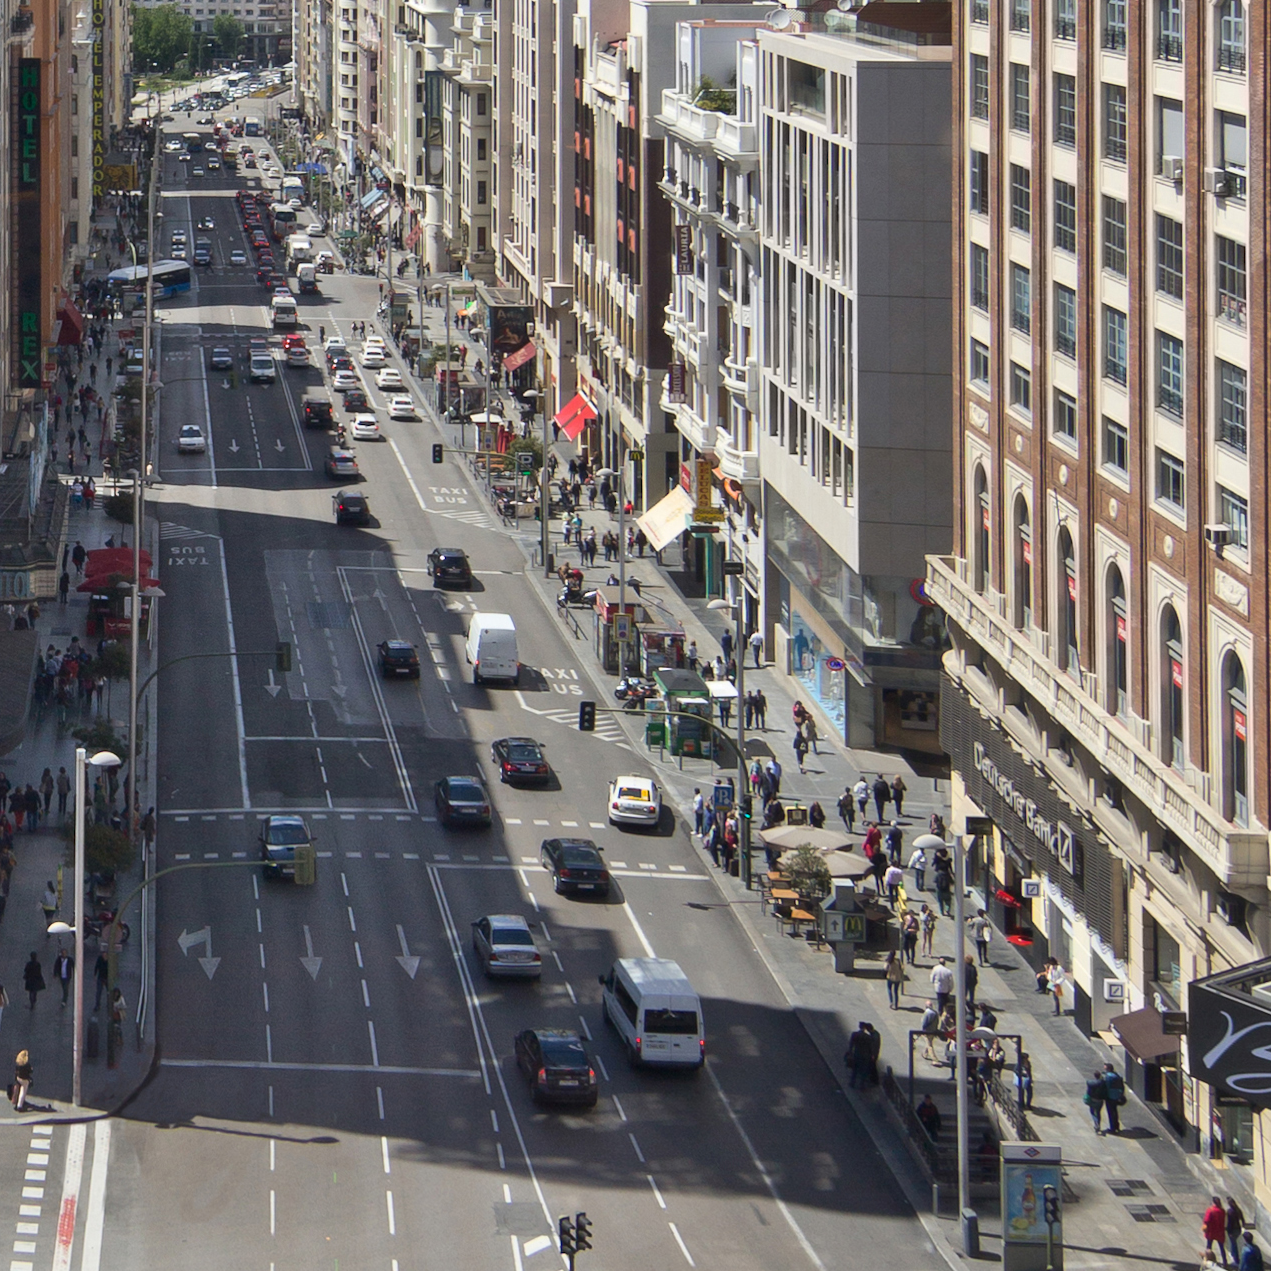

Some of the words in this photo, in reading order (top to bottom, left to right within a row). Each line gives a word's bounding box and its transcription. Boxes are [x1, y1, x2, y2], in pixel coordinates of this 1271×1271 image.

[22, 67, 38, 183] HOTEL
[93, 74, 103, 196] EMPERADOR
[681, 226, 689, 263] LAURIA
[21, 312, 39, 380] REX
[428, 487, 468, 495] TAXI
[434, 495, 467, 504] BUS
[699, 462, 709, 506] PELUCAS
[169, 557, 209, 566] TAXI
[171, 546, 205, 554] BUS
[973, 741, 1026, 824] Deutsche
[1025, 798, 1058, 856] Bank
